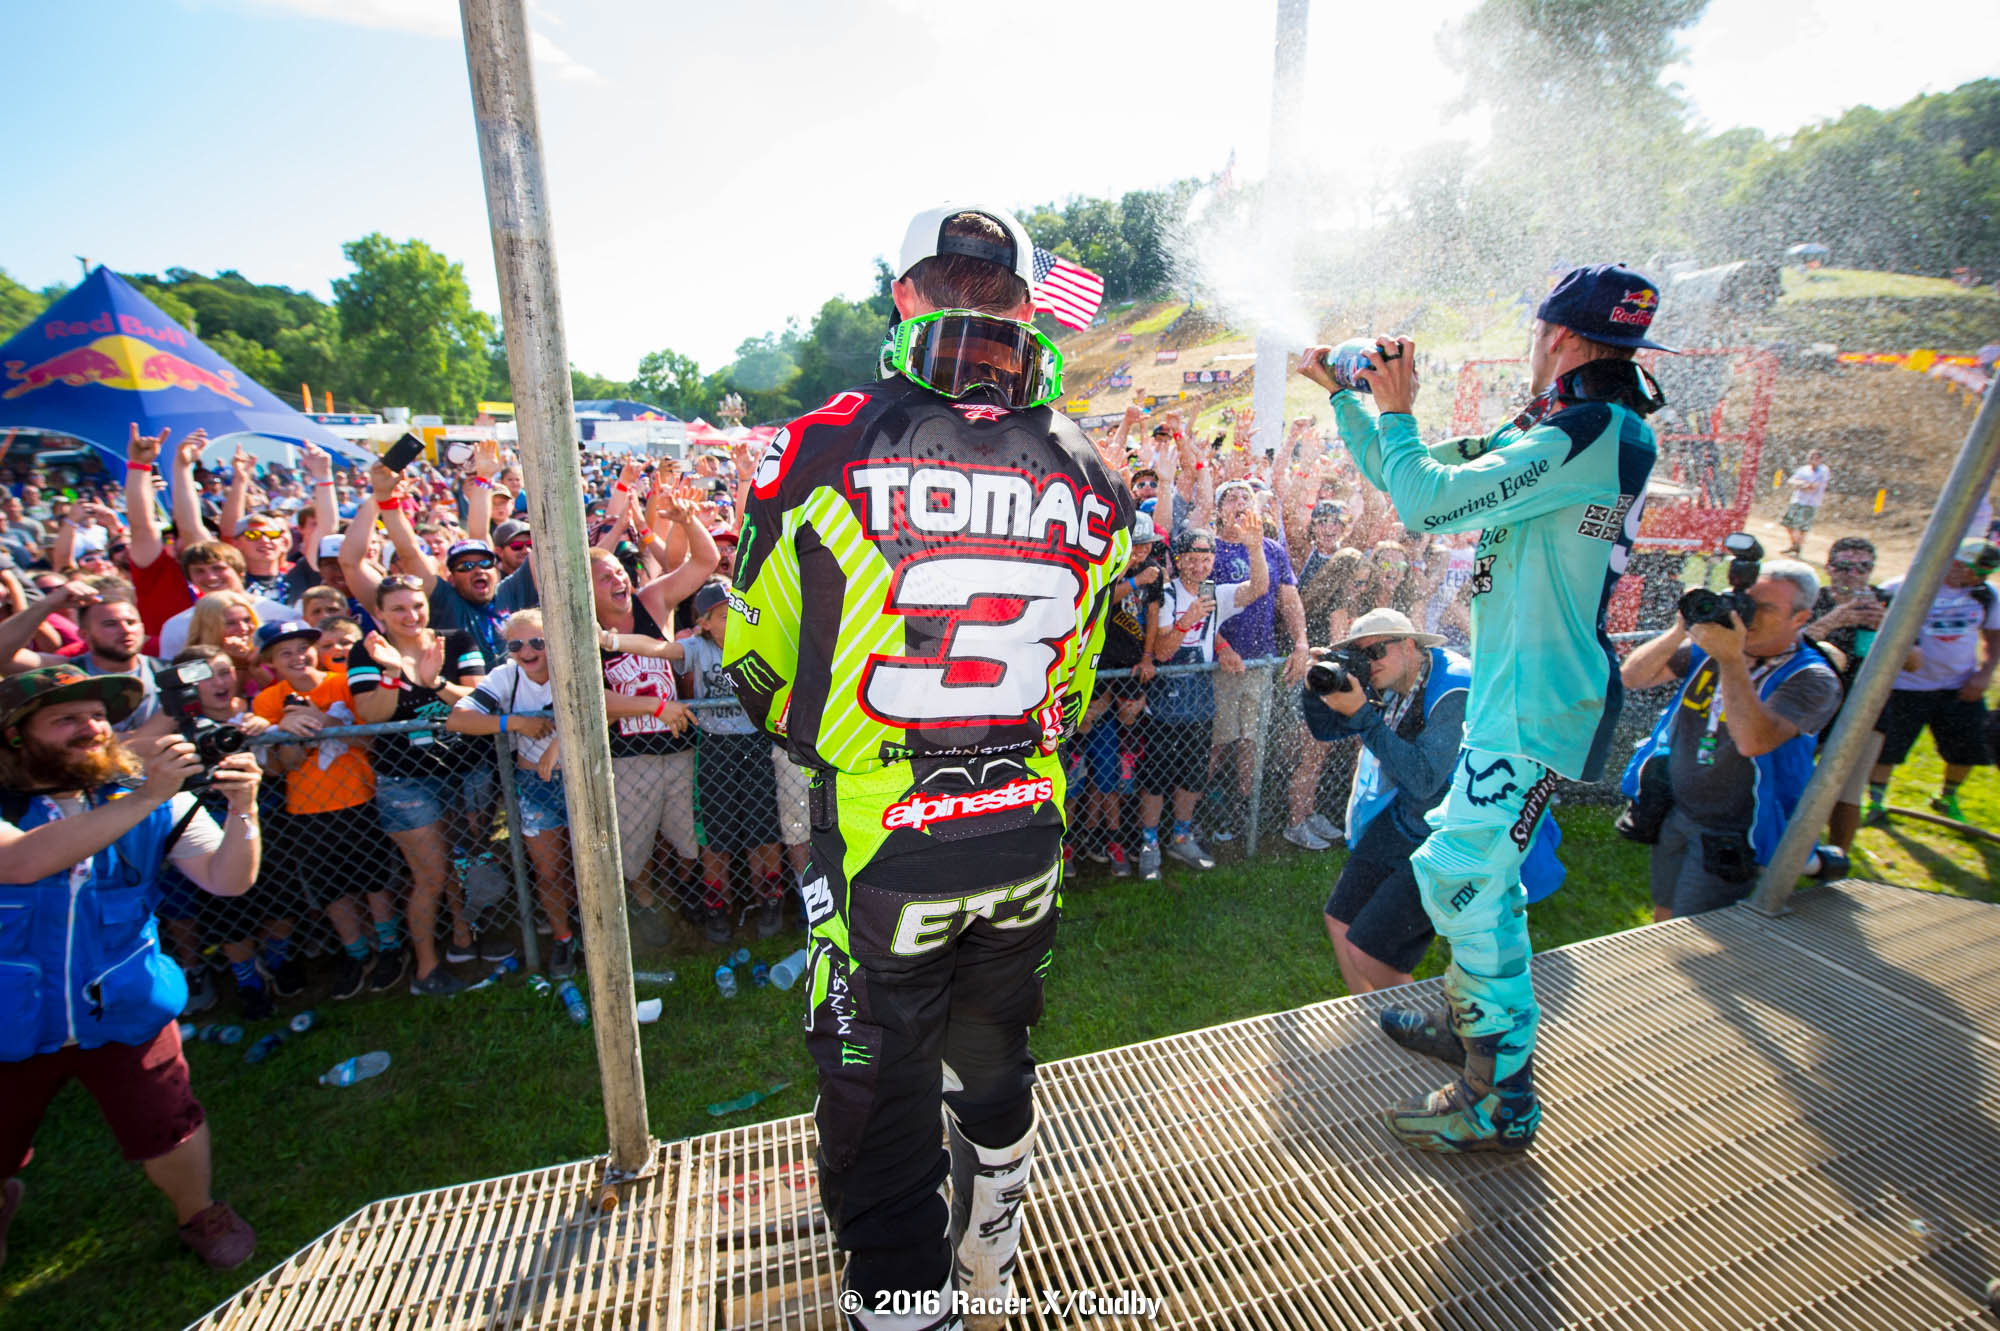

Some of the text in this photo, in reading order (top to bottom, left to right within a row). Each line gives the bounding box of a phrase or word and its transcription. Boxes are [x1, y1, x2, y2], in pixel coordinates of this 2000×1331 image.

[44, 311, 187, 348] Red Bull
[1609, 306, 1640, 324] Red
[894, 325, 905, 362] OAKLEY
[853, 467, 1110, 556] TOMAC
[1424, 459, 1550, 530] Soaring Eagle
[867, 558, 1080, 716] 3
[885, 779, 1053, 828] alpinestars
[892, 860, 1060, 956] ET3
[1450, 881, 1480, 912] FOX
